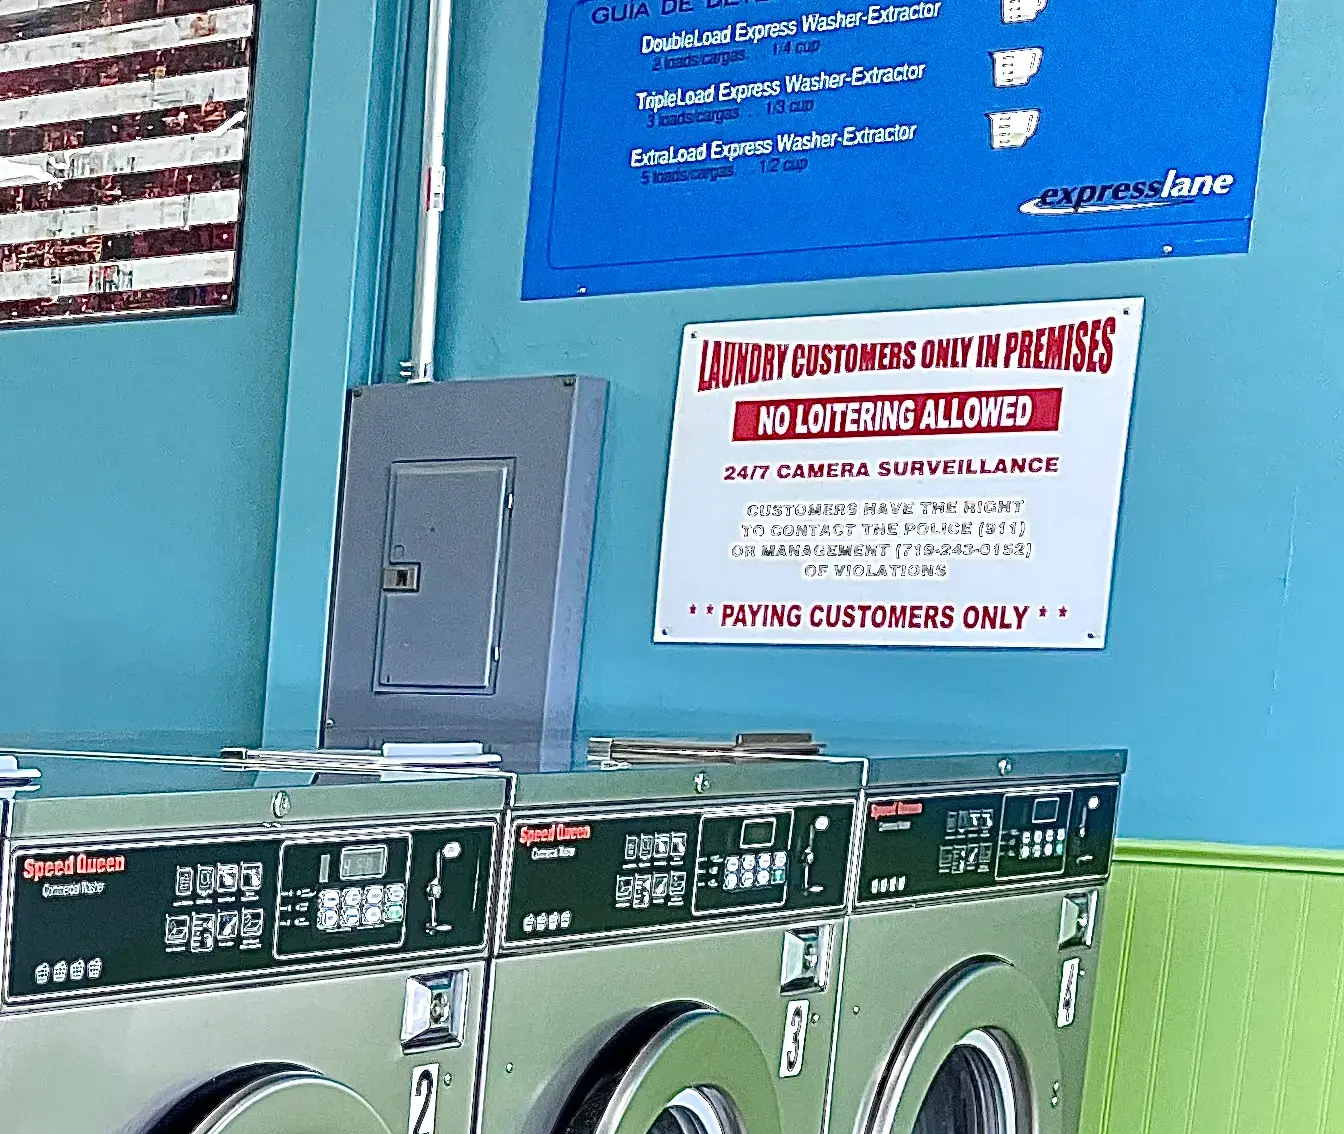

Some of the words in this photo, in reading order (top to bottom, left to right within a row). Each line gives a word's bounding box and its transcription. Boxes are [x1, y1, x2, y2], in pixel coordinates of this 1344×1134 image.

[641, 25, 732, 53] DoubleLoad
[735, 20, 798, 43] Express
[802, 2, 942, 33] Washer-Extractor
[636, 85, 714, 113] TripleLoad
[719, 80, 780, 104] Express
[785, 63, 926, 94] Washer-Extractor
[630, 143, 707, 168] ExtraLoad
[711, 139, 772, 161] Express
[777, 123, 917, 153] Washer-Extractor
[1037, 169, 1234, 212] expresslane
[698, 338, 787, 392] LAUNDRY
[791, 340, 916, 378] CUSTOMERS
[921, 335, 973, 370] ONLY
[977, 334, 1000, 368] IN
[1003, 316, 1116, 374] PREMISES
[757, 405, 791, 436] NO
[796, 400, 914, 434] LOITERING
[920, 396, 1032, 430] ALLOWED
[724, 464, 770, 481] 24/7
[777, 462, 870, 480] CAMERA
[879, 457, 1060, 476] SURVEILLANCE
[746, 502, 858, 517] CUSTOMERS
[863, 502, 913, 515] HAVE
[920, 501, 957, 515] THE
[963, 500, 1024, 514] RIGHT
[742, 524, 765, 537] TO
[770, 524, 857, 537] CONTACT
[862, 523, 898, 536] THE
[903, 522, 972, 536] POLICE
[978, 520, 1026, 538] (911)
[732, 545, 756, 558] OR
[762, 543, 890, 558] MANAGEMENT
[804, 564, 829, 577] OF
[834, 564, 947, 577] VIOLATIONS
[720, 604, 802, 627] PAYING
[810, 605, 955, 629] CUSTOMERS
[963, 605, 1030, 630] ONLY
[519, 824, 555, 847] Speed
[23, 854, 74, 881] Speed
[77, 853, 125, 873] Queen
[787, 1005, 803, 1073] 3
